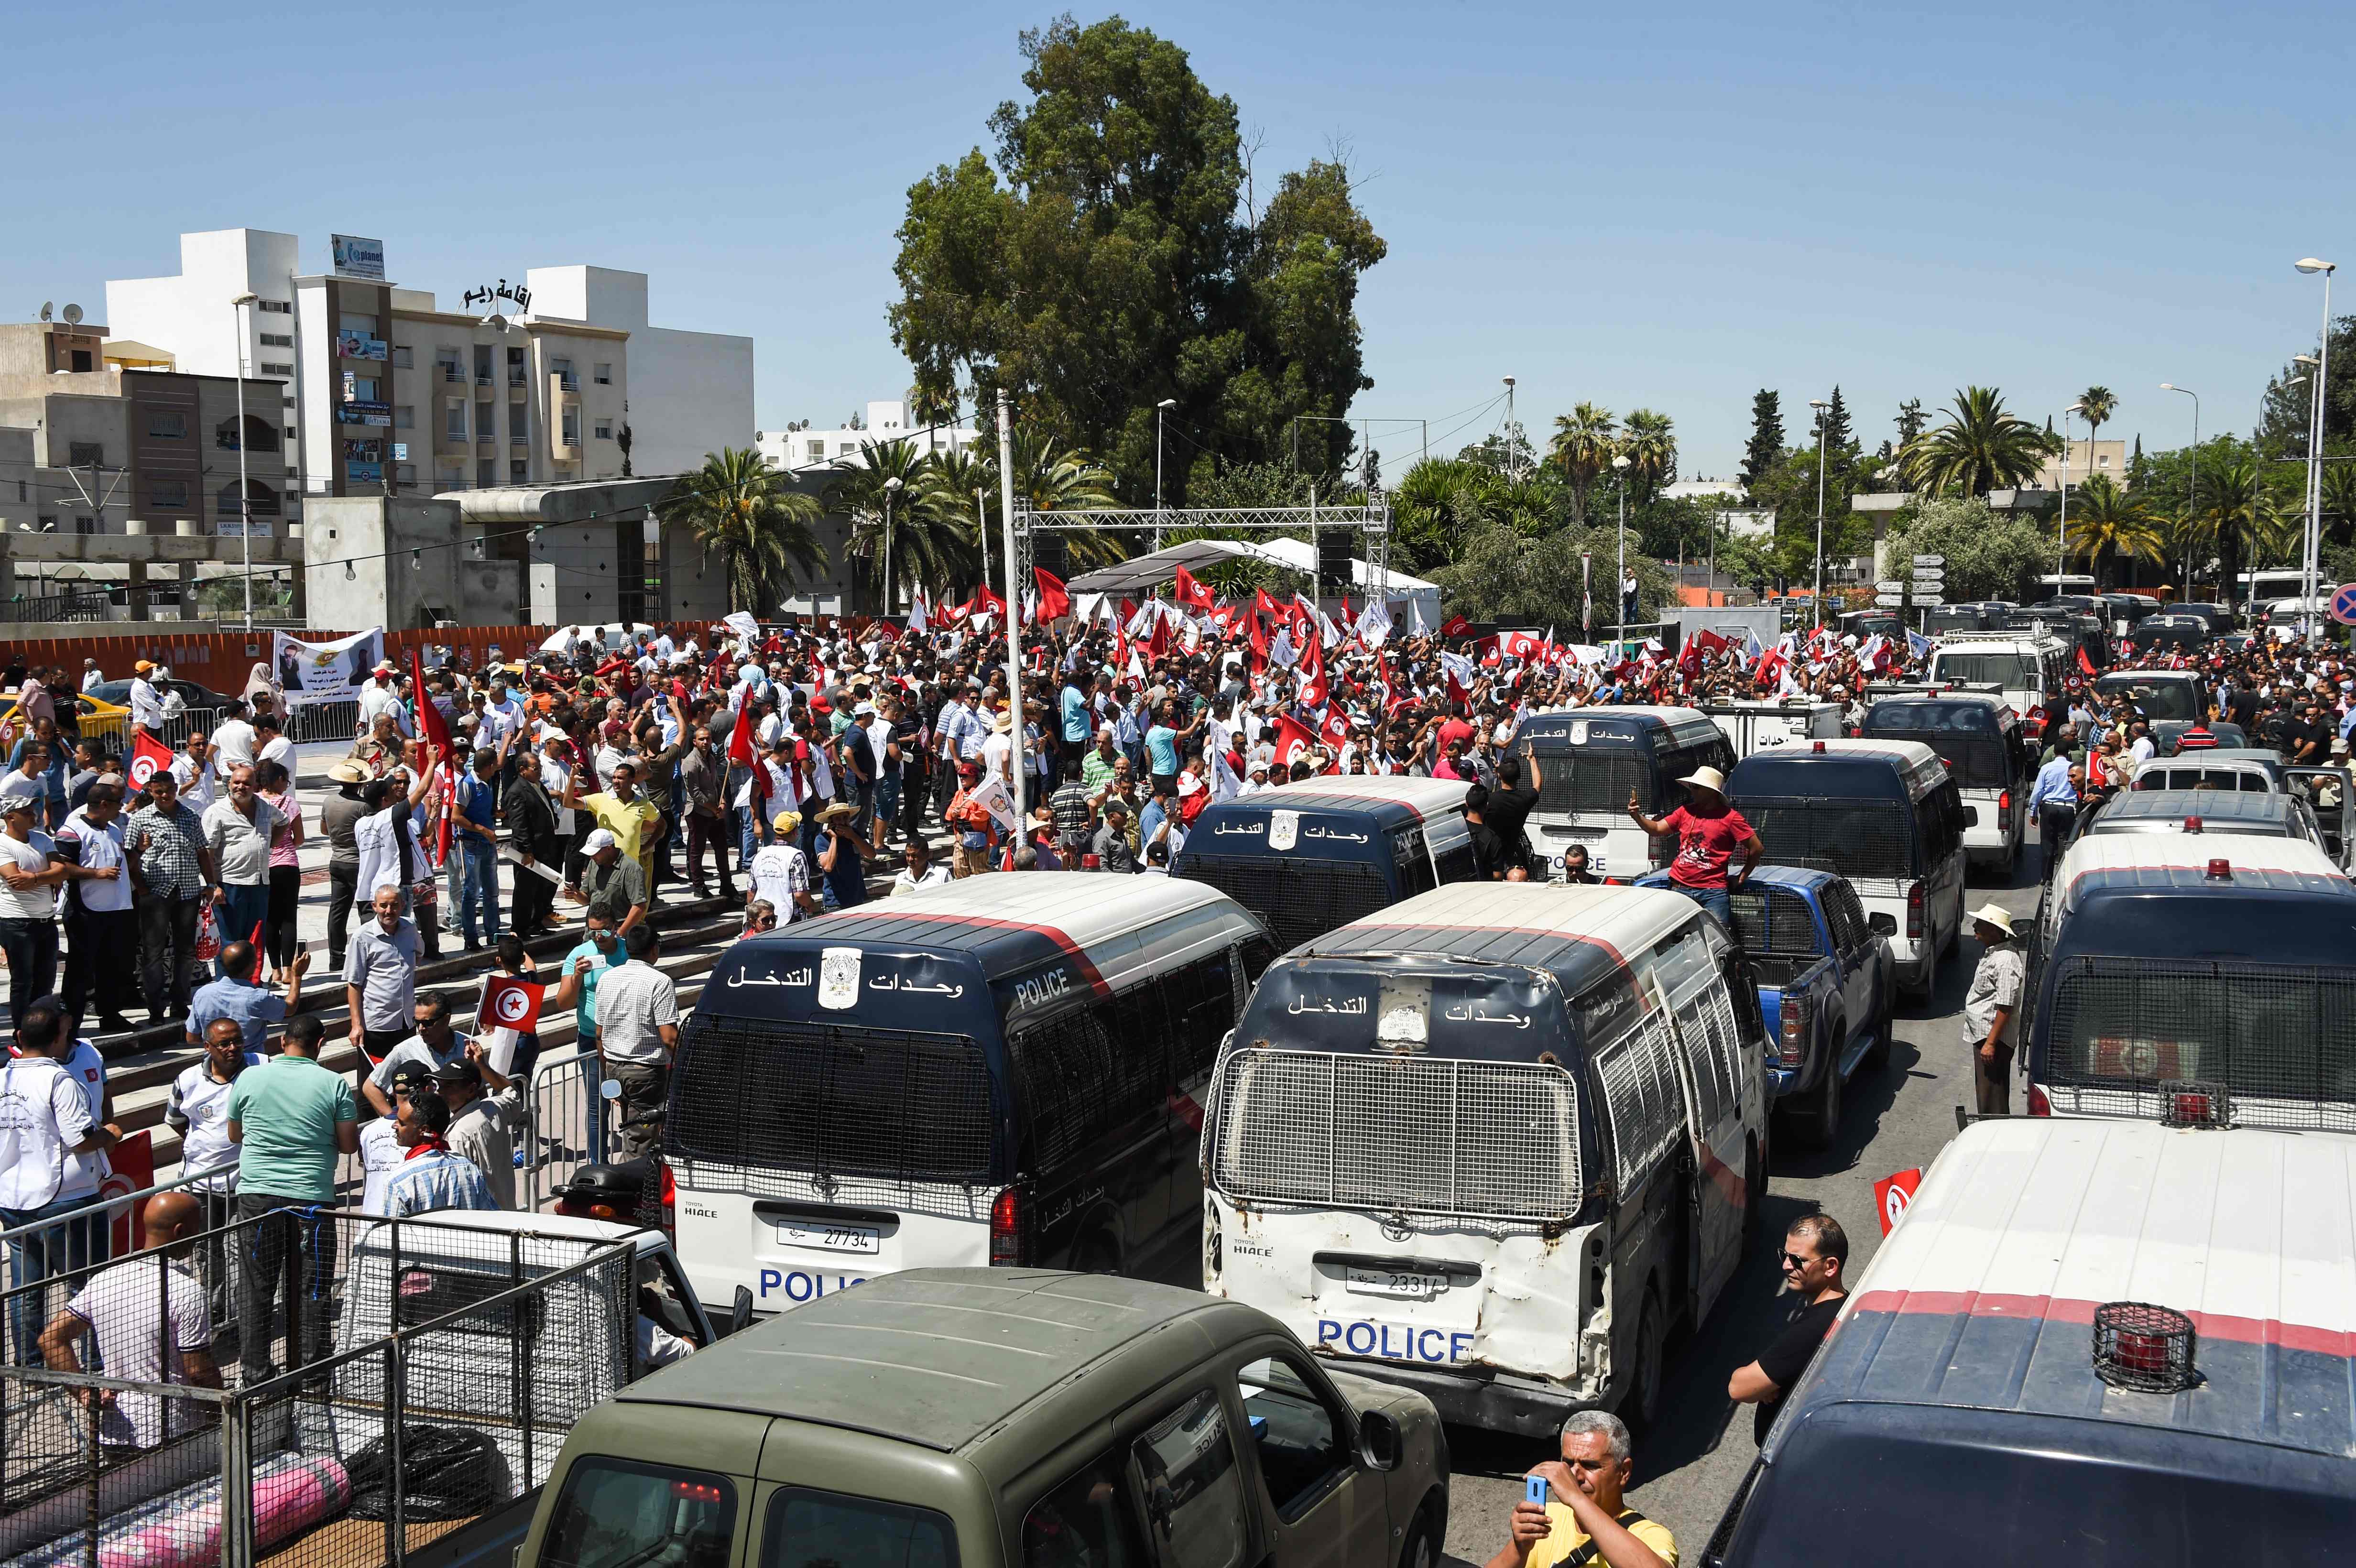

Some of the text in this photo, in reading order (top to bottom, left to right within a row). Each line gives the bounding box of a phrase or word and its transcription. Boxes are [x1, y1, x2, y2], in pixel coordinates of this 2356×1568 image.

[464, 285, 493, 308] ريم
[1522, 729, 1635, 741] وحدات التدخل
[1759, 734, 1789, 746] حدات
[1214, 822, 1368, 843] وحدات التدخل
[1395, 828, 1421, 851] POLICE
[1547, 856, 1606, 871] POCE
[727, 966, 963, 998] وحدات التدخل
[1015, 968, 1070, 1010] POLICE
[1288, 994, 1530, 1029] وحدات التدخل
[685, 1208, 717, 1218] HIACE
[1042, 1197, 1071, 1232] التدخل
[824, 1229, 868, 1248] 27734
[1234, 1245, 1272, 1257] HIACE
